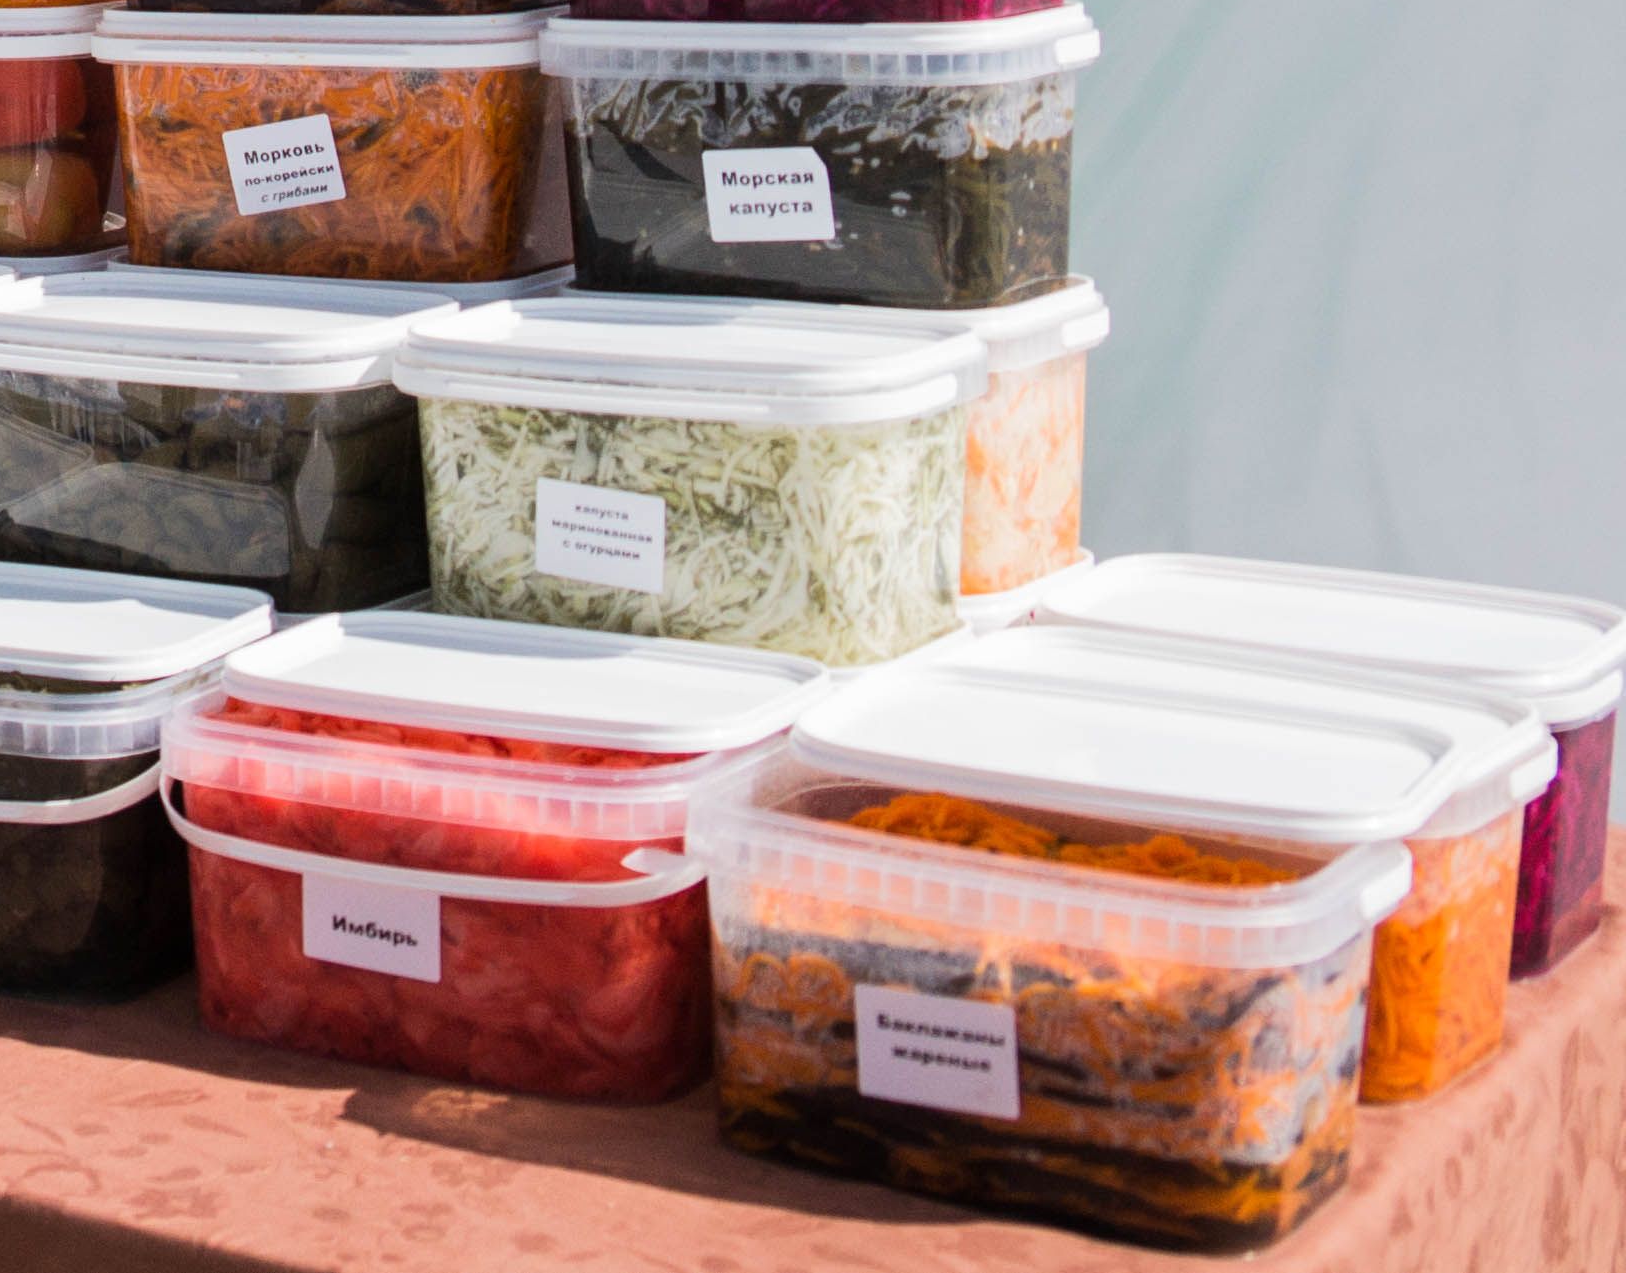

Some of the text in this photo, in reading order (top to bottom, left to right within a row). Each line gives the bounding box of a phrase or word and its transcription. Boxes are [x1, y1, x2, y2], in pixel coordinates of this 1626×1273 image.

[244, 143, 324, 166] Морковь
[245, 164, 334, 187] по-корейски
[722, 170, 814, 189] Морская
[261, 184, 329, 203] с грибами
[729, 200, 814, 218] капуста
[574, 504, 629, 521] капуста
[551, 518, 653, 544] маринованная
[562, 539, 640, 560] с огурцами
[332, 914, 418, 947] Имбирь
[876, 1013, 1006, 1047] Баклажаны
[891, 1046, 992, 1073] жареные
